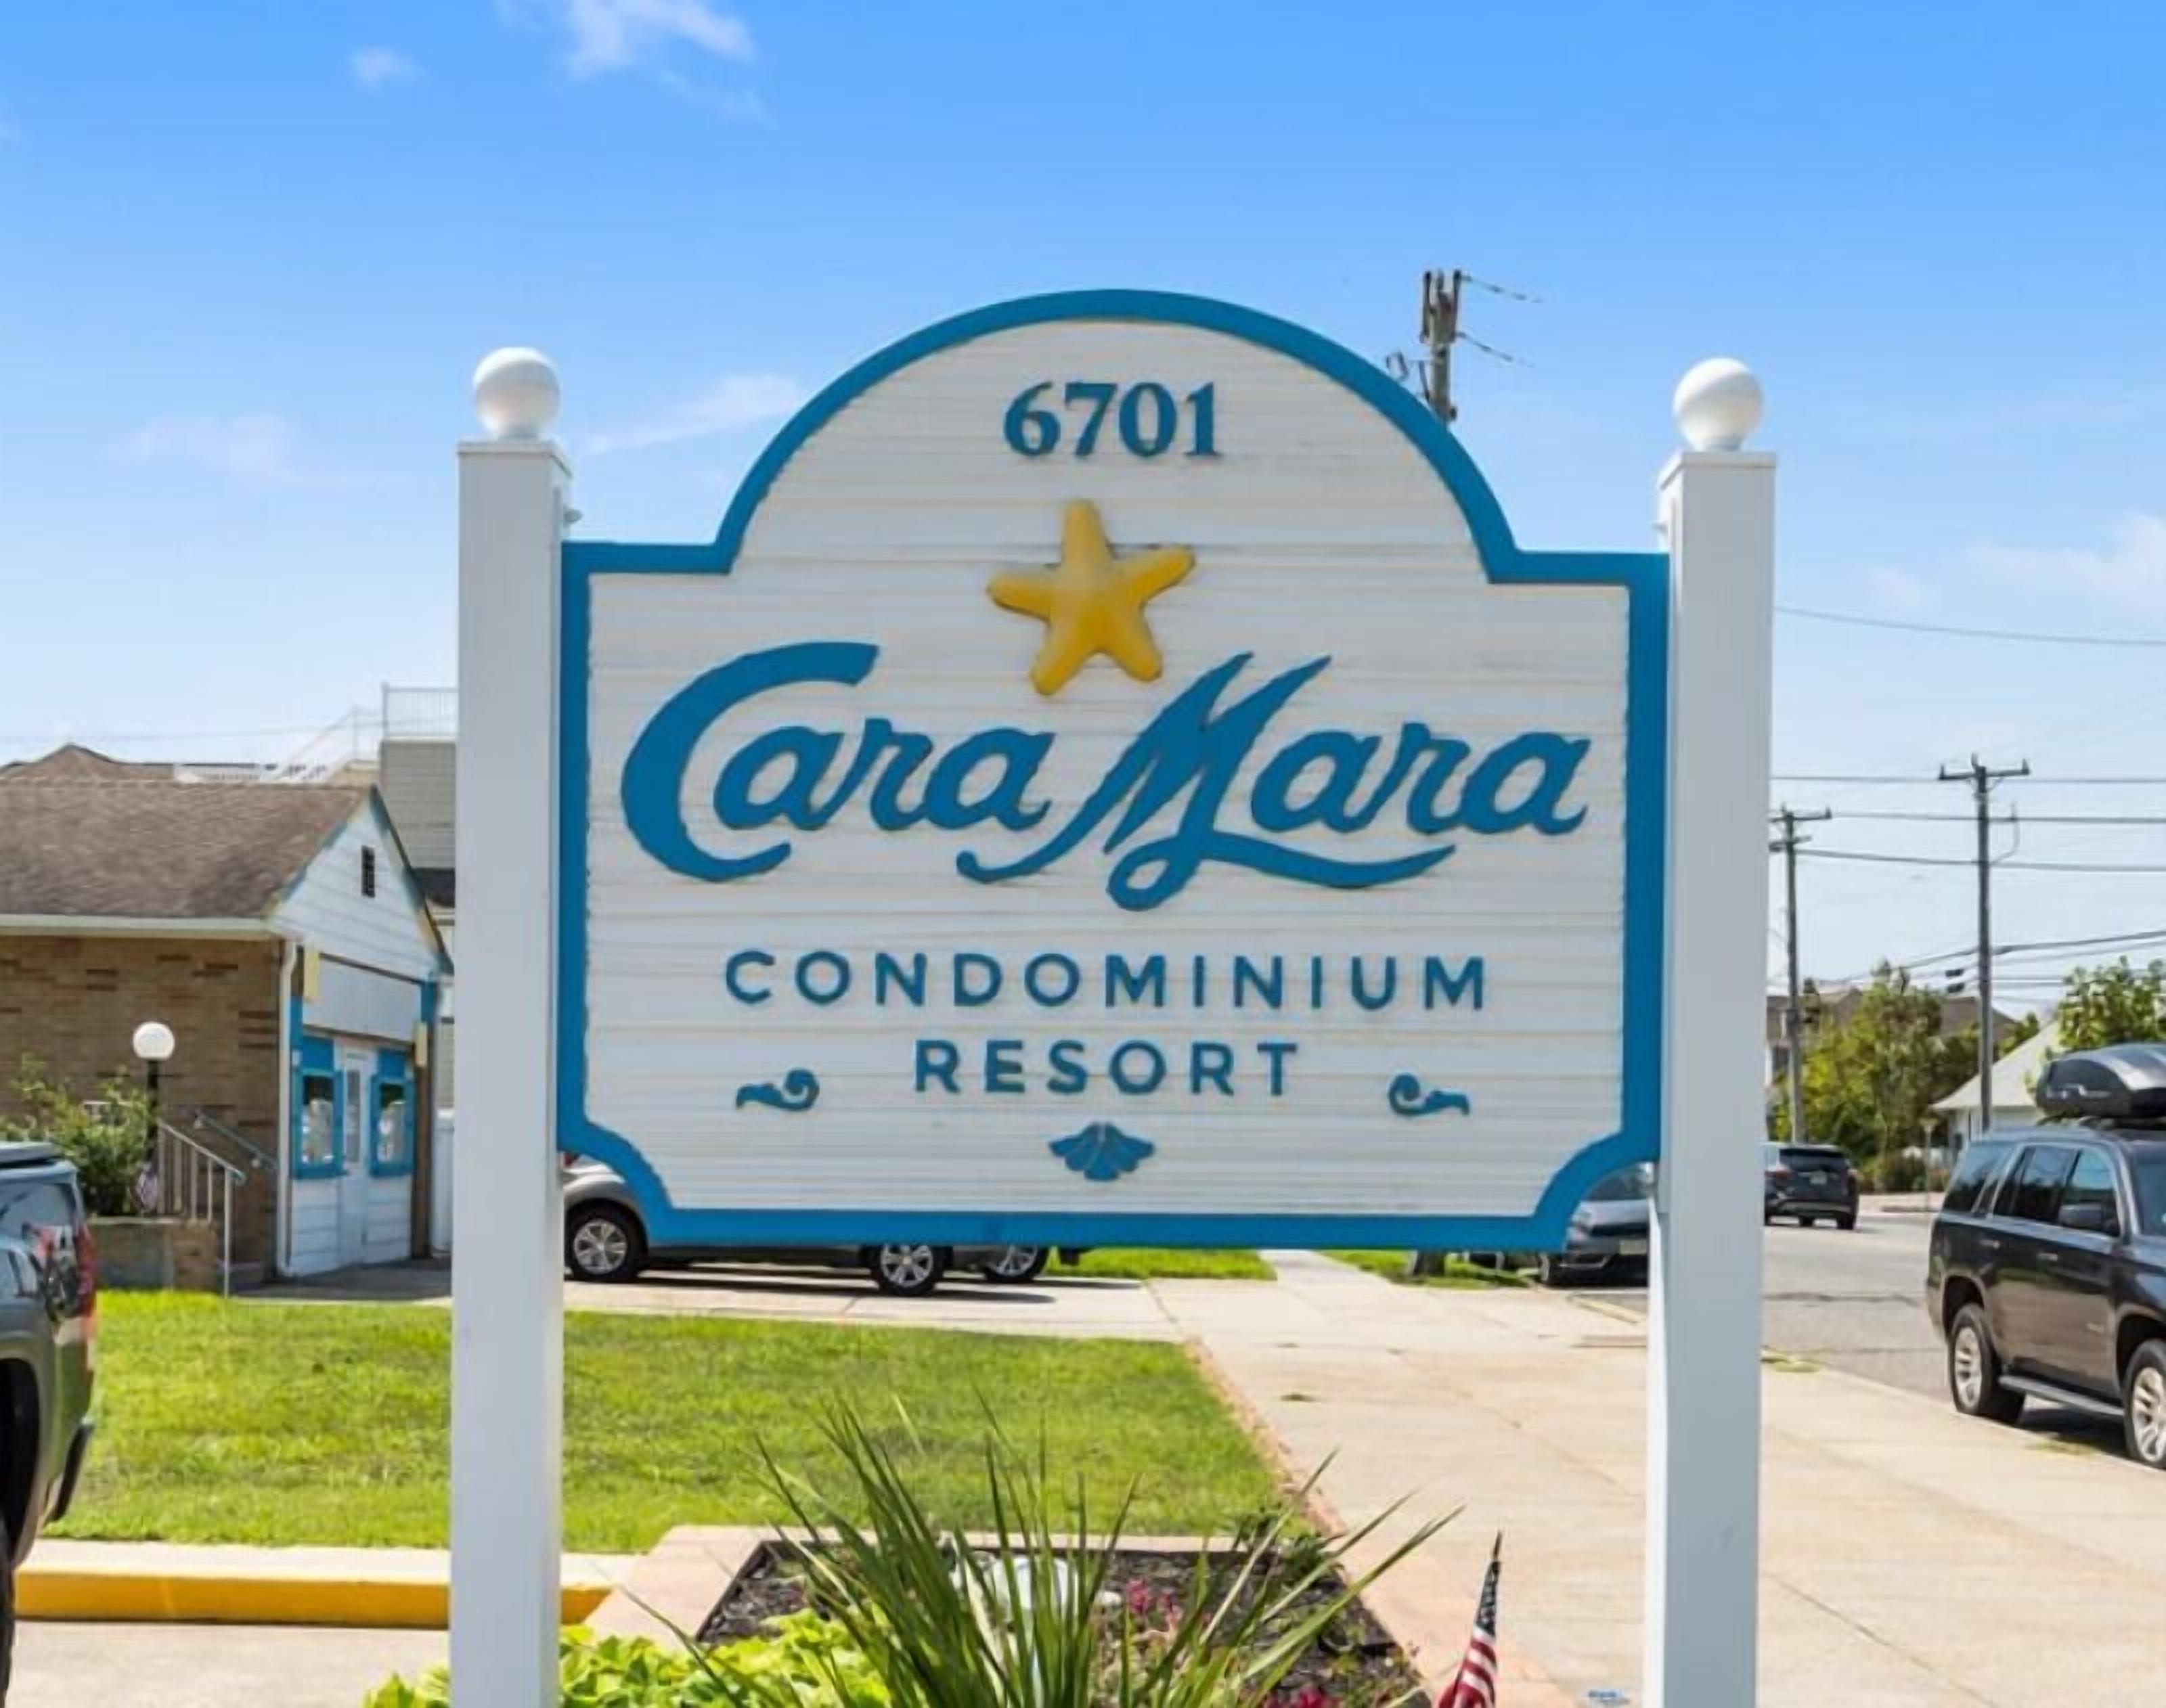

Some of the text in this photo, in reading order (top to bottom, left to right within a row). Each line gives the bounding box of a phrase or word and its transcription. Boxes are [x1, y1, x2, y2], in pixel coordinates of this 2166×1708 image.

[1003, 378, 1224, 459] 6701
[619, 637, 1590, 912] Cara Mara
[724, 949, 1488, 1010] CONDOMINIUM
[912, 1037, 1300, 1096] RESORT
